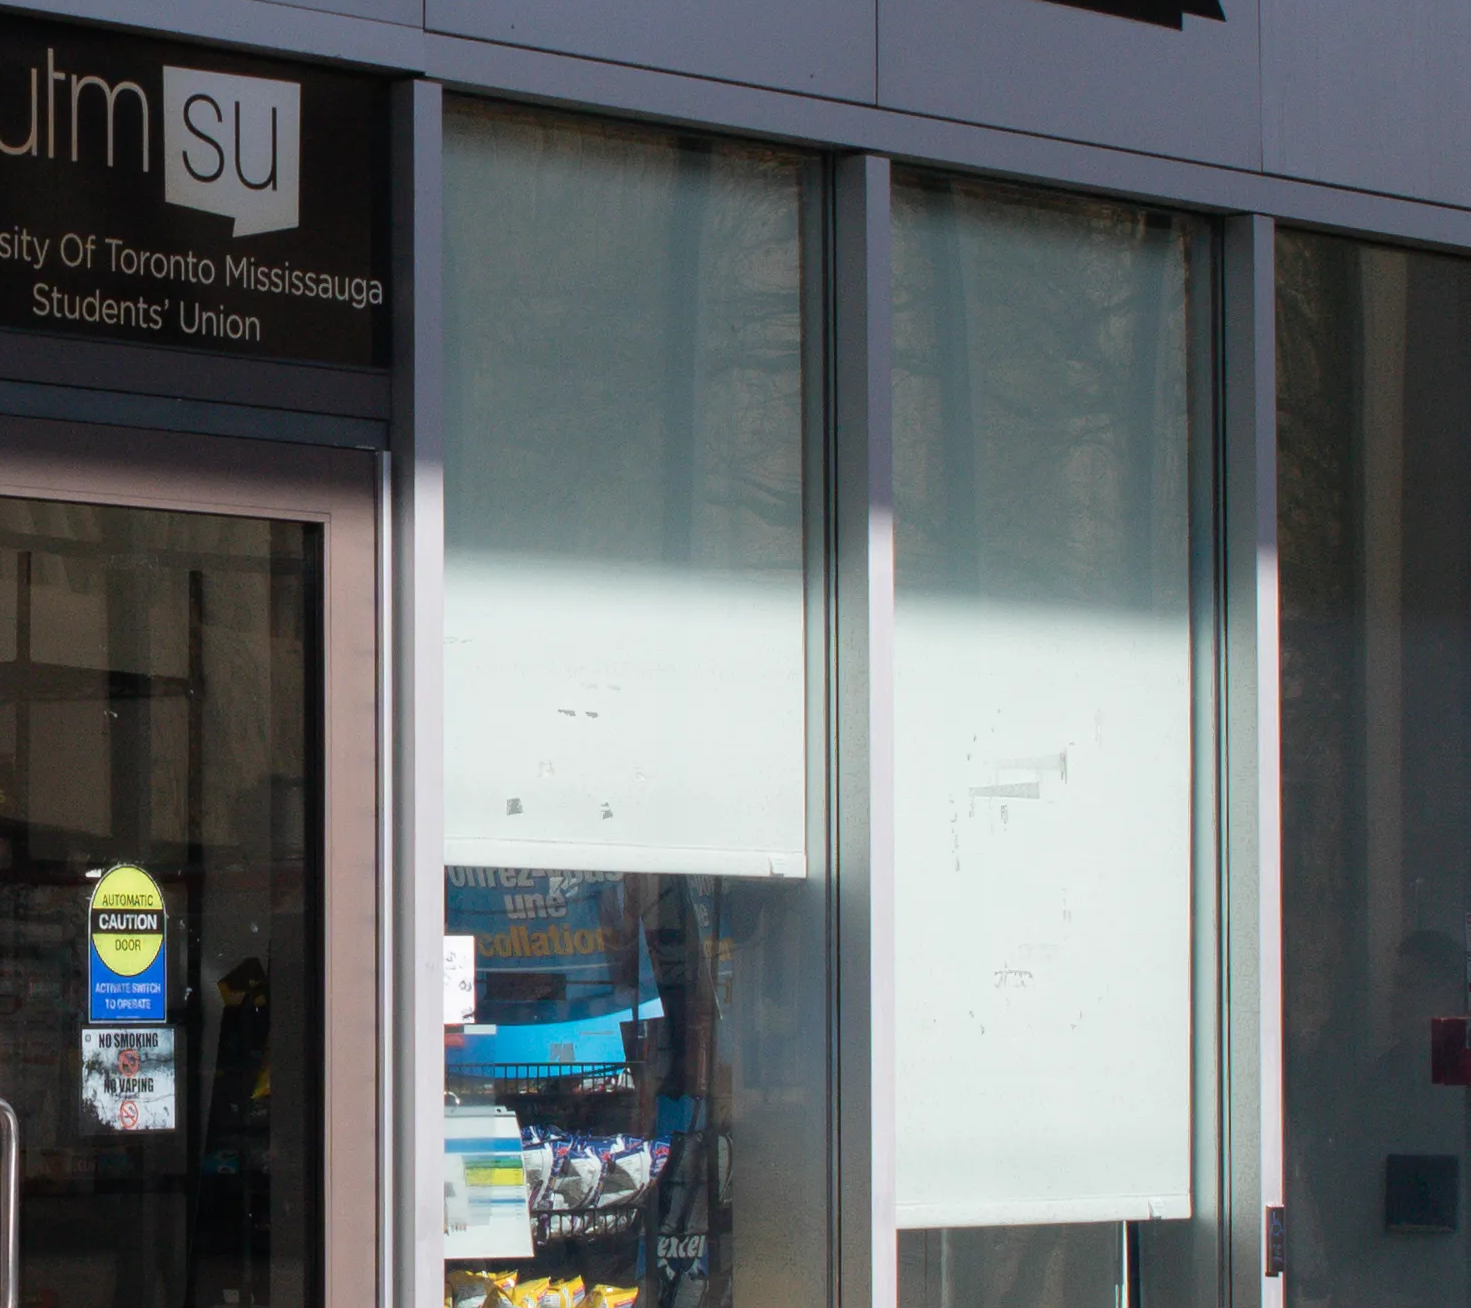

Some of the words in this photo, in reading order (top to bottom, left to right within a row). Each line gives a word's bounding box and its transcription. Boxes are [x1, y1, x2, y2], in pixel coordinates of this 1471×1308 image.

[60, 232, 96, 268] Of
[105, 239, 215, 285] Toronto
[226, 254, 383, 309] Mississauga
[32, 282, 169, 330] Students'
[180, 305, 260, 341] Union
[102, 894, 154, 906] AUTOMATIC
[98, 913, 158, 930] CAUTION
[114, 939, 141, 952] DOOR
[95, 982, 130, 994] ACTIVATE
[132, 982, 161, 994] SWITCH
[105, 998, 114, 1010] TO
[116, 998, 151, 1010] OPERATE
[98, 1033, 112, 1048] NO
[114, 1033, 159, 1048] SMOKING
[103, 1078, 117, 1094] NO
[119, 1078, 154, 1094] VAPING
[657, 1234, 706, 1259] excel
